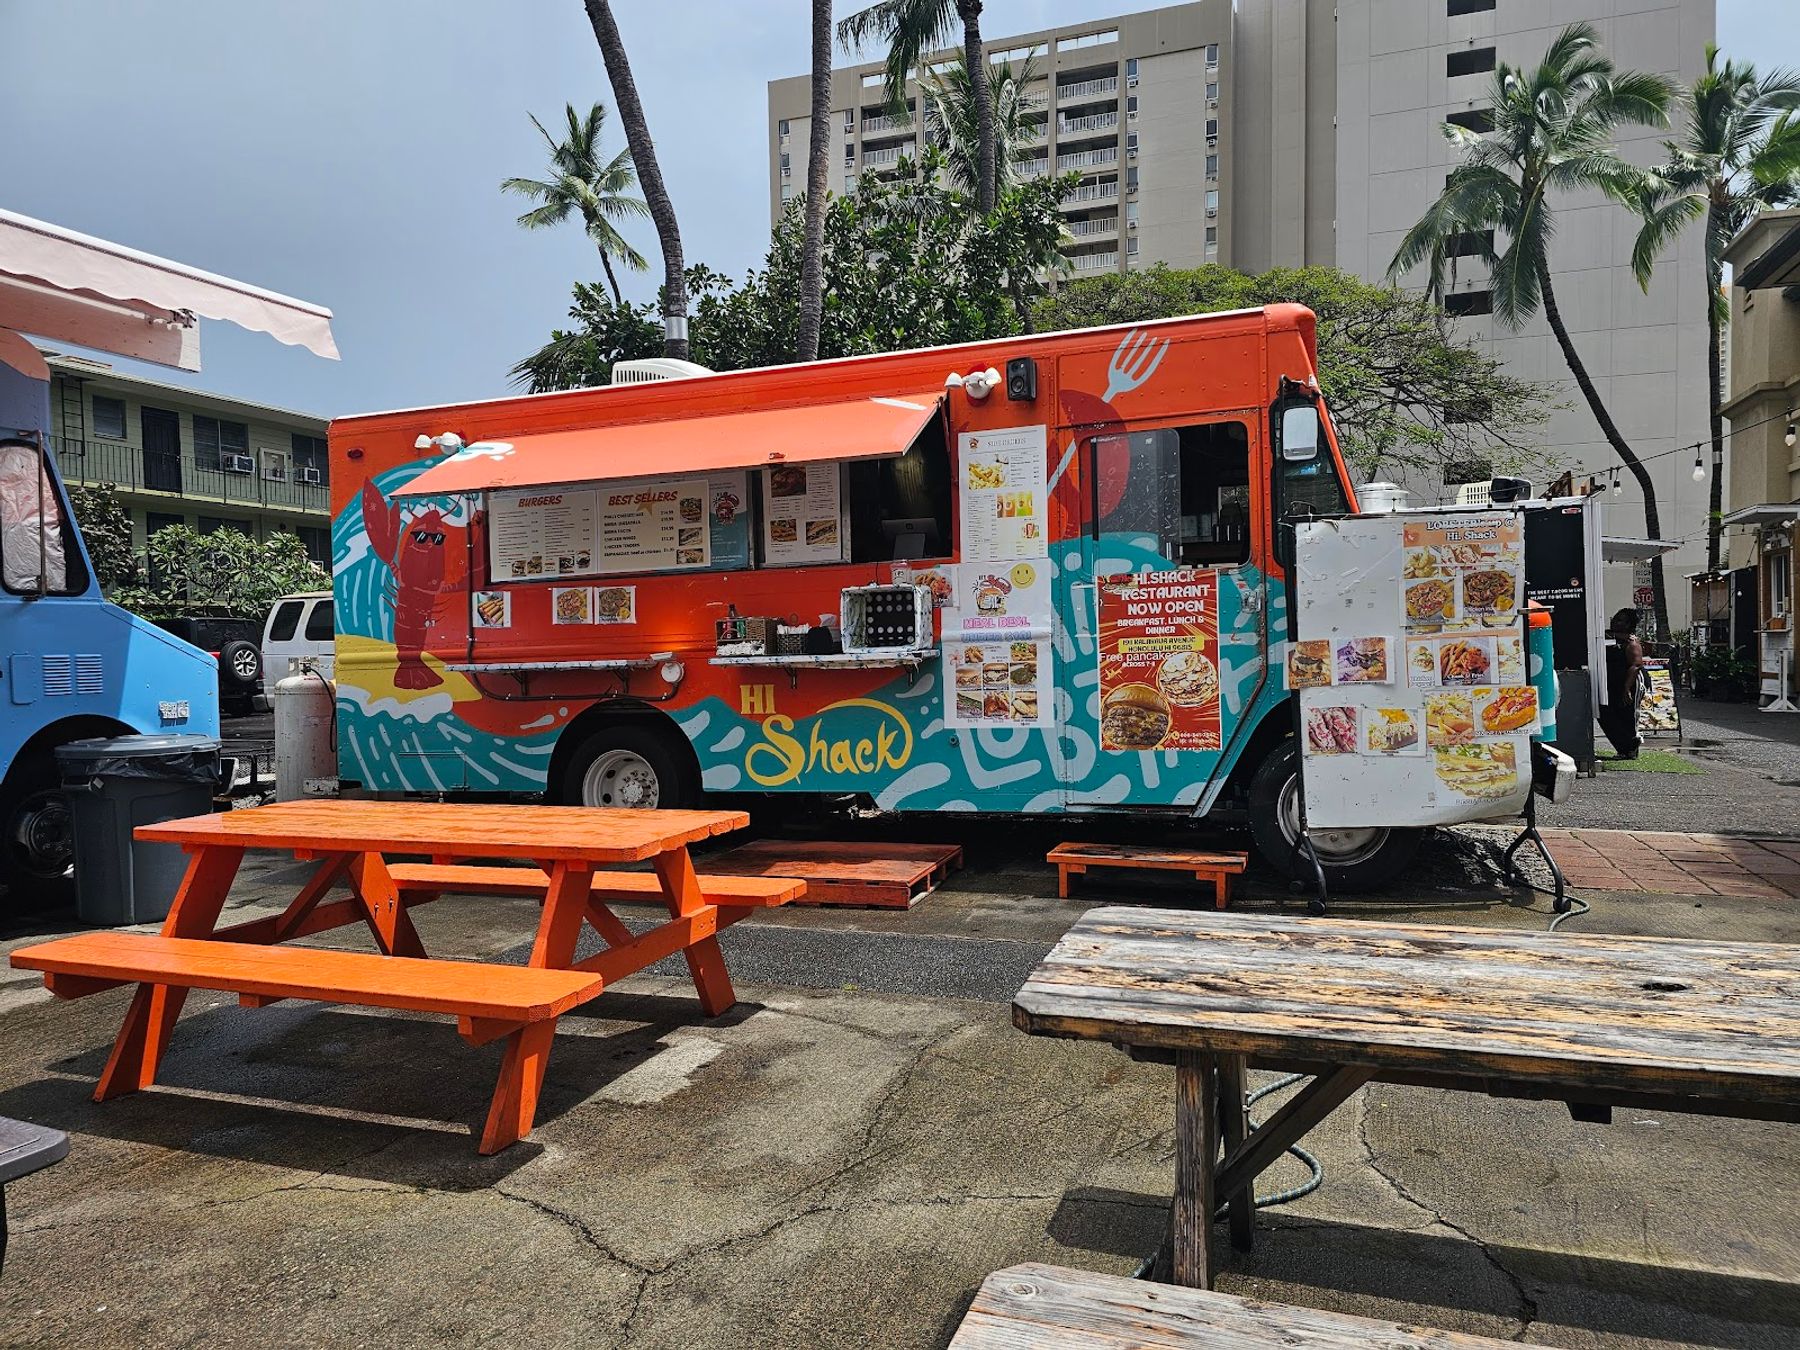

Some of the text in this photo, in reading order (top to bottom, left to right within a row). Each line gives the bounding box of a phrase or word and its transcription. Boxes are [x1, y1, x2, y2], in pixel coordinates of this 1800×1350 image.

[518, 495, 563, 508] BURGERS
[608, 491, 678, 506] BEST SELLERS
[1463, 529, 1498, 540] Shack
[1121, 584, 1210, 601] RESTAURANT
[1127, 600, 1204, 615] NOW OPEN
[998, 615, 1031, 627] DEAL
[1168, 616, 1196, 625] LUNCH
[1145, 626, 1176, 635] DINNER
[1100, 653, 1123, 662] Free
[739, 684, 776, 714] HI
[745, 698, 913, 786] Shack
